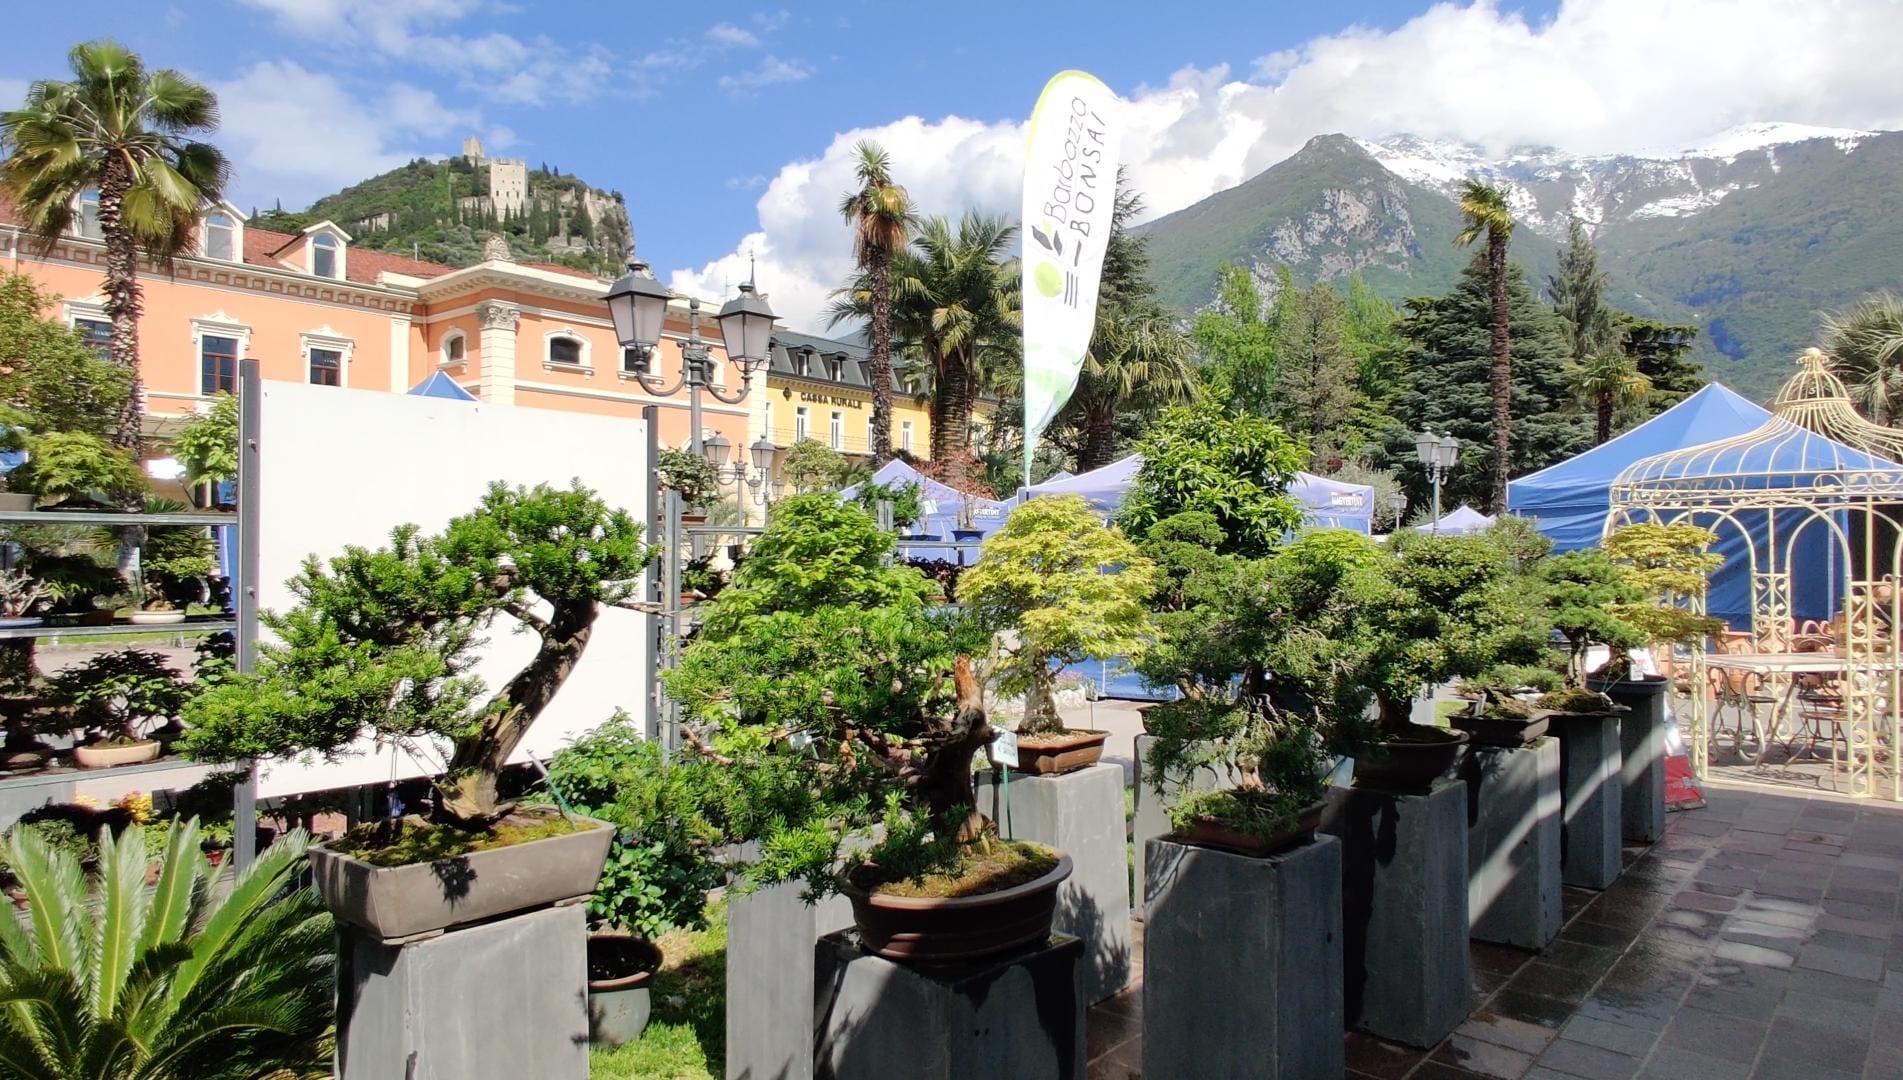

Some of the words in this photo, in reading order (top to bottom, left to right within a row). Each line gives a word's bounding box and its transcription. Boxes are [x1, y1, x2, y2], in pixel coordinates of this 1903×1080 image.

[1069, 110, 1106, 237] BONSAI
[800, 391, 829, 405] CASSA
[830, 396, 863, 410] RURALE
